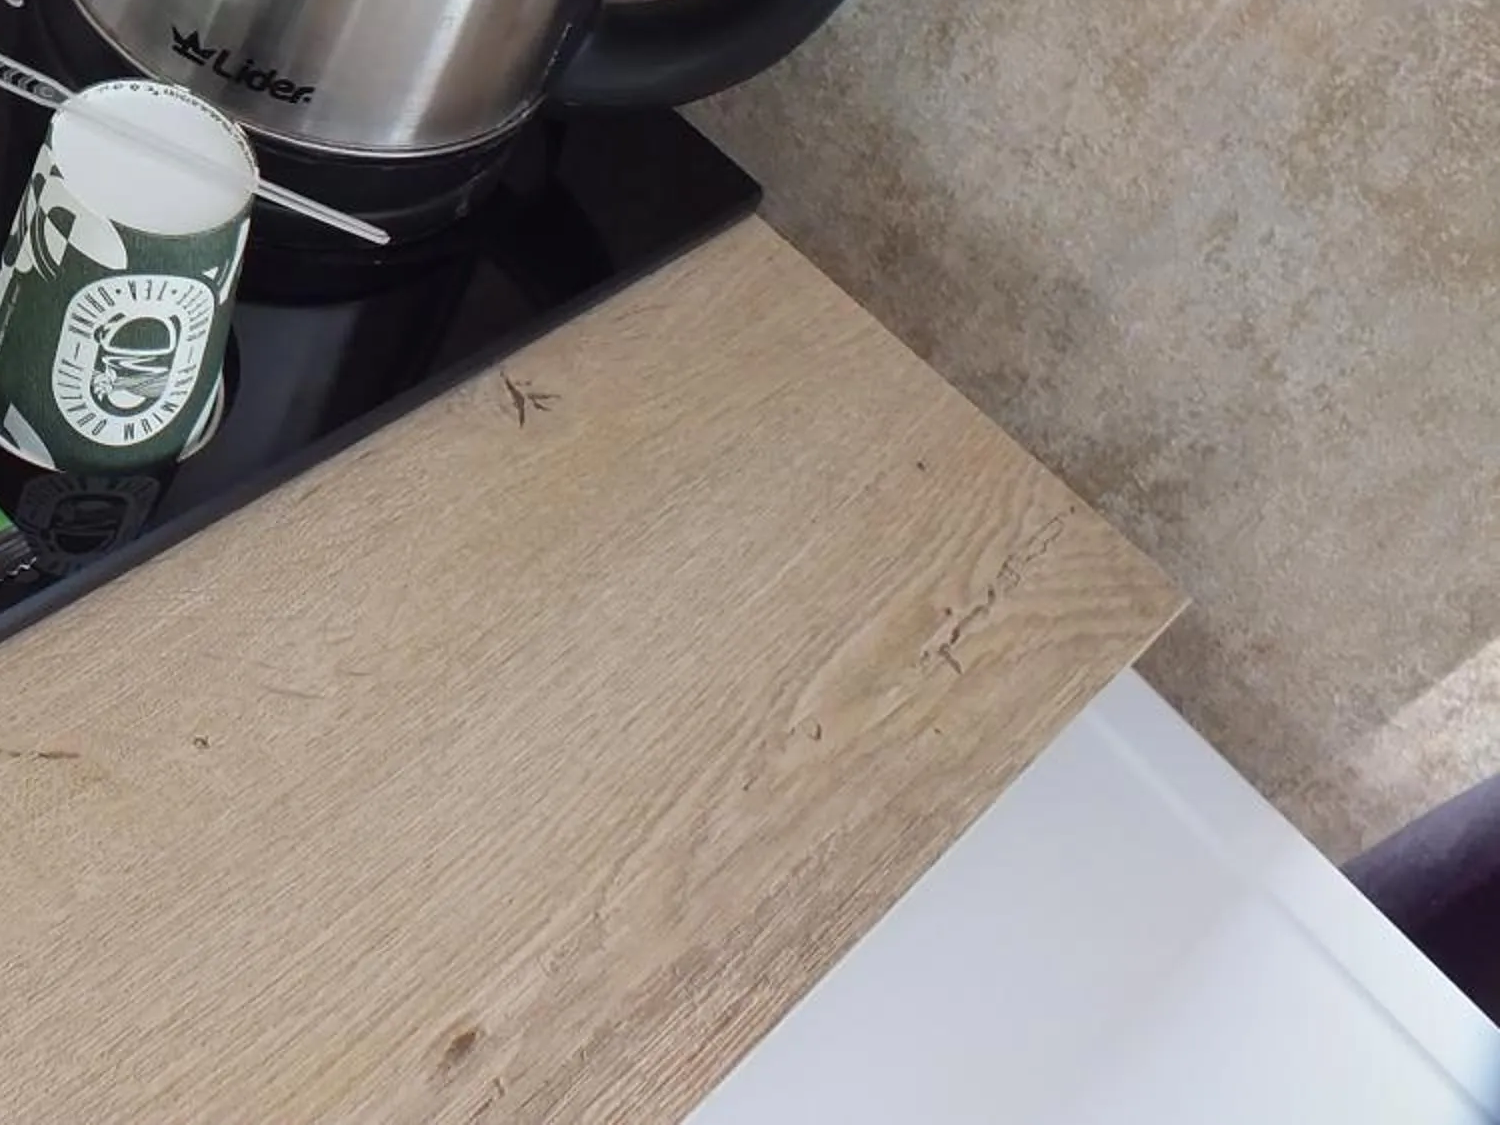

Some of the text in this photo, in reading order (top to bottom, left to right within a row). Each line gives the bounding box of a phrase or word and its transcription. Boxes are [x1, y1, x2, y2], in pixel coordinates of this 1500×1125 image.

[68, 284, 115, 340] DRINK
[127, 278, 168, 302] TEA
[56, 358, 197, 441] PREMIUM QUALITY
